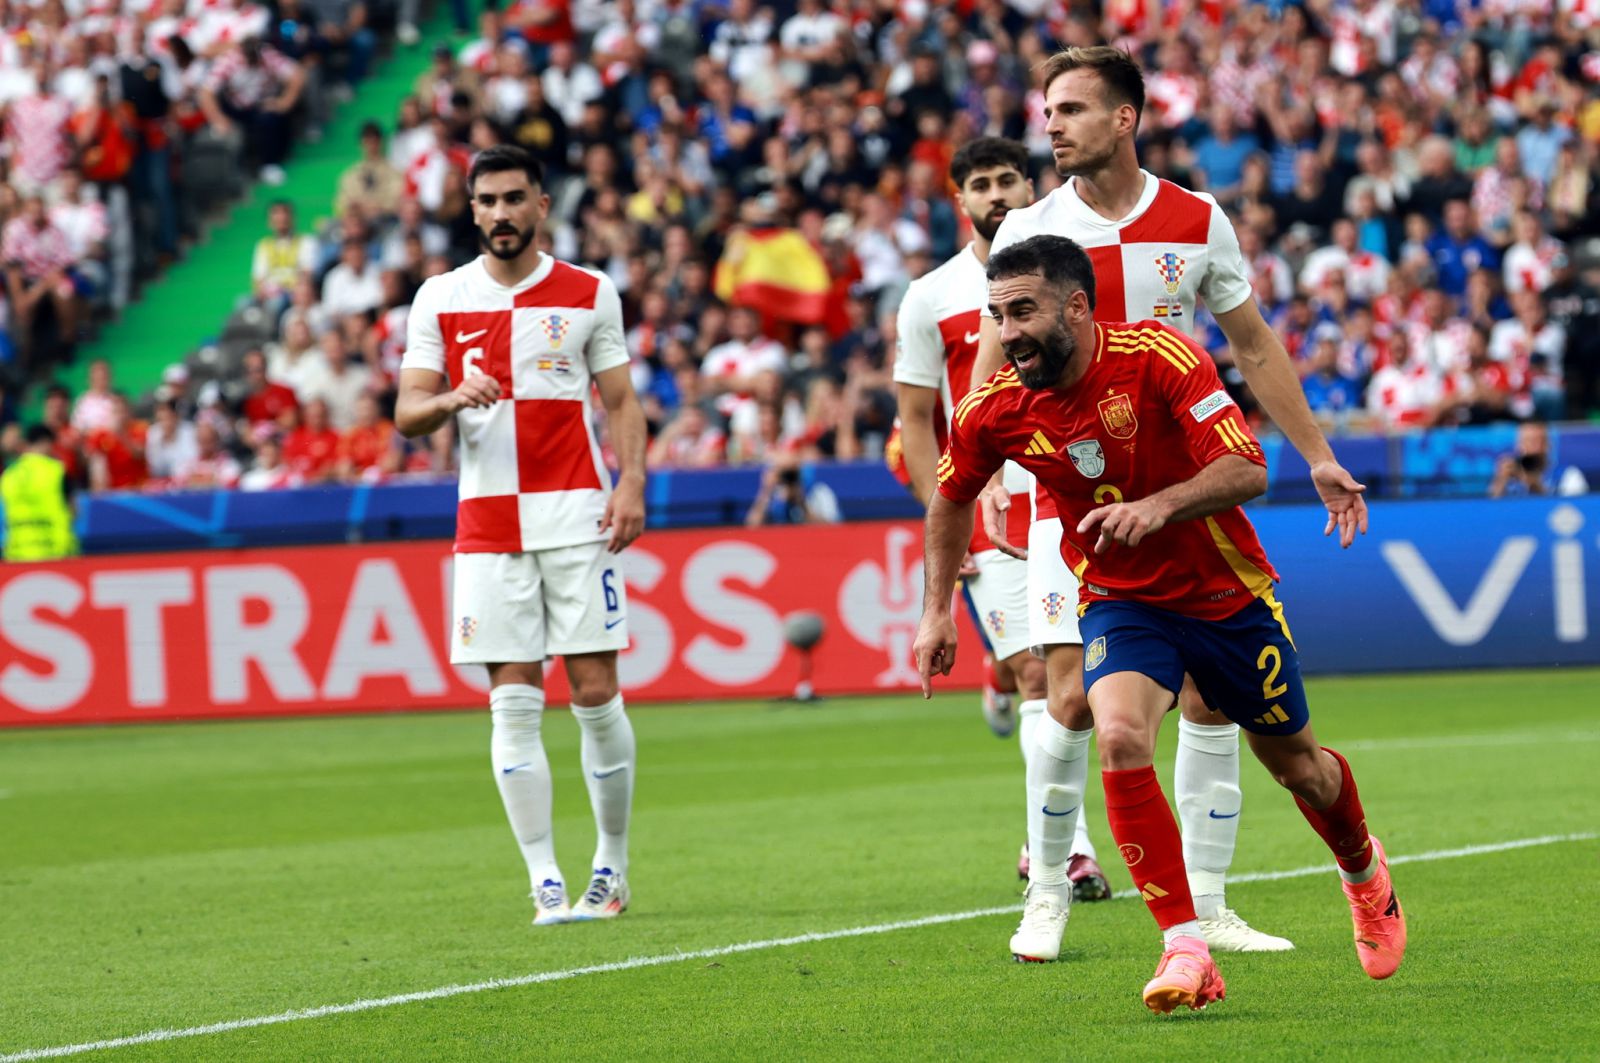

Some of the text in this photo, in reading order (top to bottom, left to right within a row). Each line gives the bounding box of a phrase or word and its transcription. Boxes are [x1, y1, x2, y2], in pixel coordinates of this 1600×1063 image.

[1194, 395, 1224, 416] FOUNDA
[601, 568, 619, 612] 6
[1380, 503, 1600, 646] vi
[0, 540, 786, 714] STRASS
[1256, 644, 1288, 700] 2
